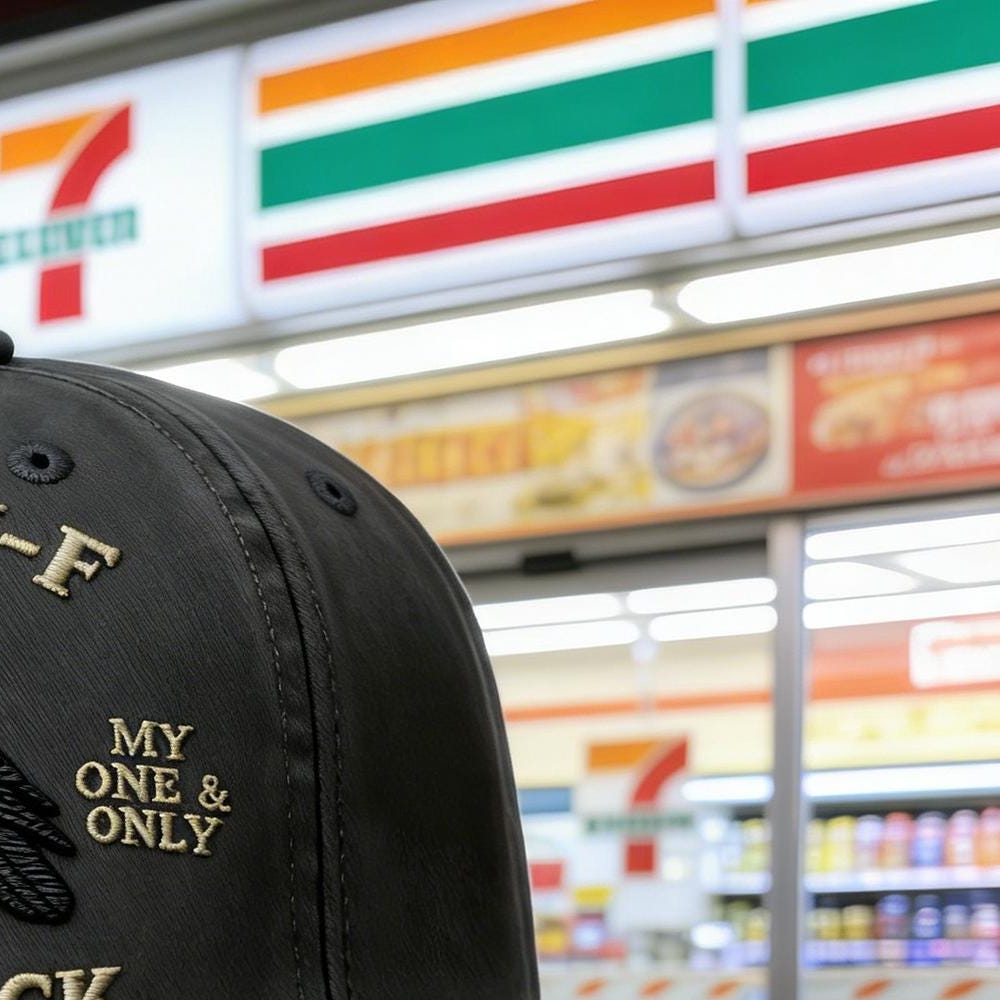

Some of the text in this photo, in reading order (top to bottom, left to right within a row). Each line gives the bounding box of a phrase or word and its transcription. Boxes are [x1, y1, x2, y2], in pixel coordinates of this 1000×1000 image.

[109, 718, 193, 760] MY
[75, 762, 231, 812] ONE &
[86, 806, 223, 857] ONLY
